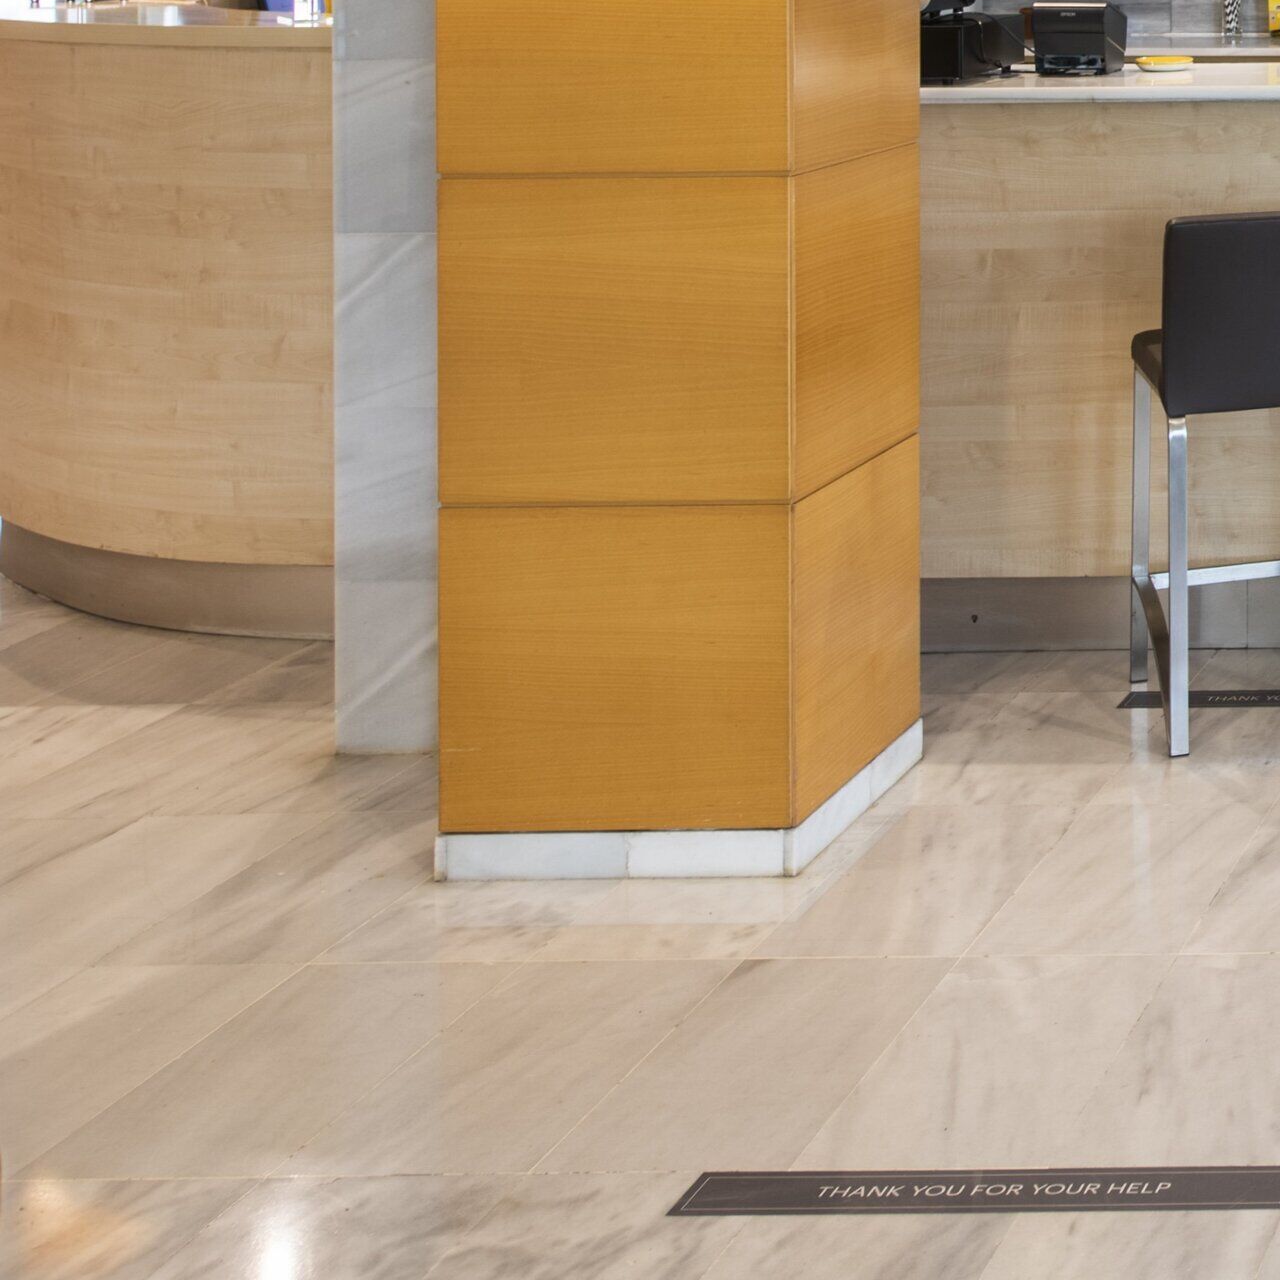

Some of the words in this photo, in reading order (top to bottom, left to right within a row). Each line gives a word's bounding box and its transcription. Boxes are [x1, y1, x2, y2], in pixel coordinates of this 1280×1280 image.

[816, 1185, 905, 1198] THANK
[912, 1184, 967, 1197] YOU
[970, 1183, 1025, 1196] FOR
[1032, 1182, 1101, 1195] YOUR
[1107, 1181, 1172, 1194] HELP
